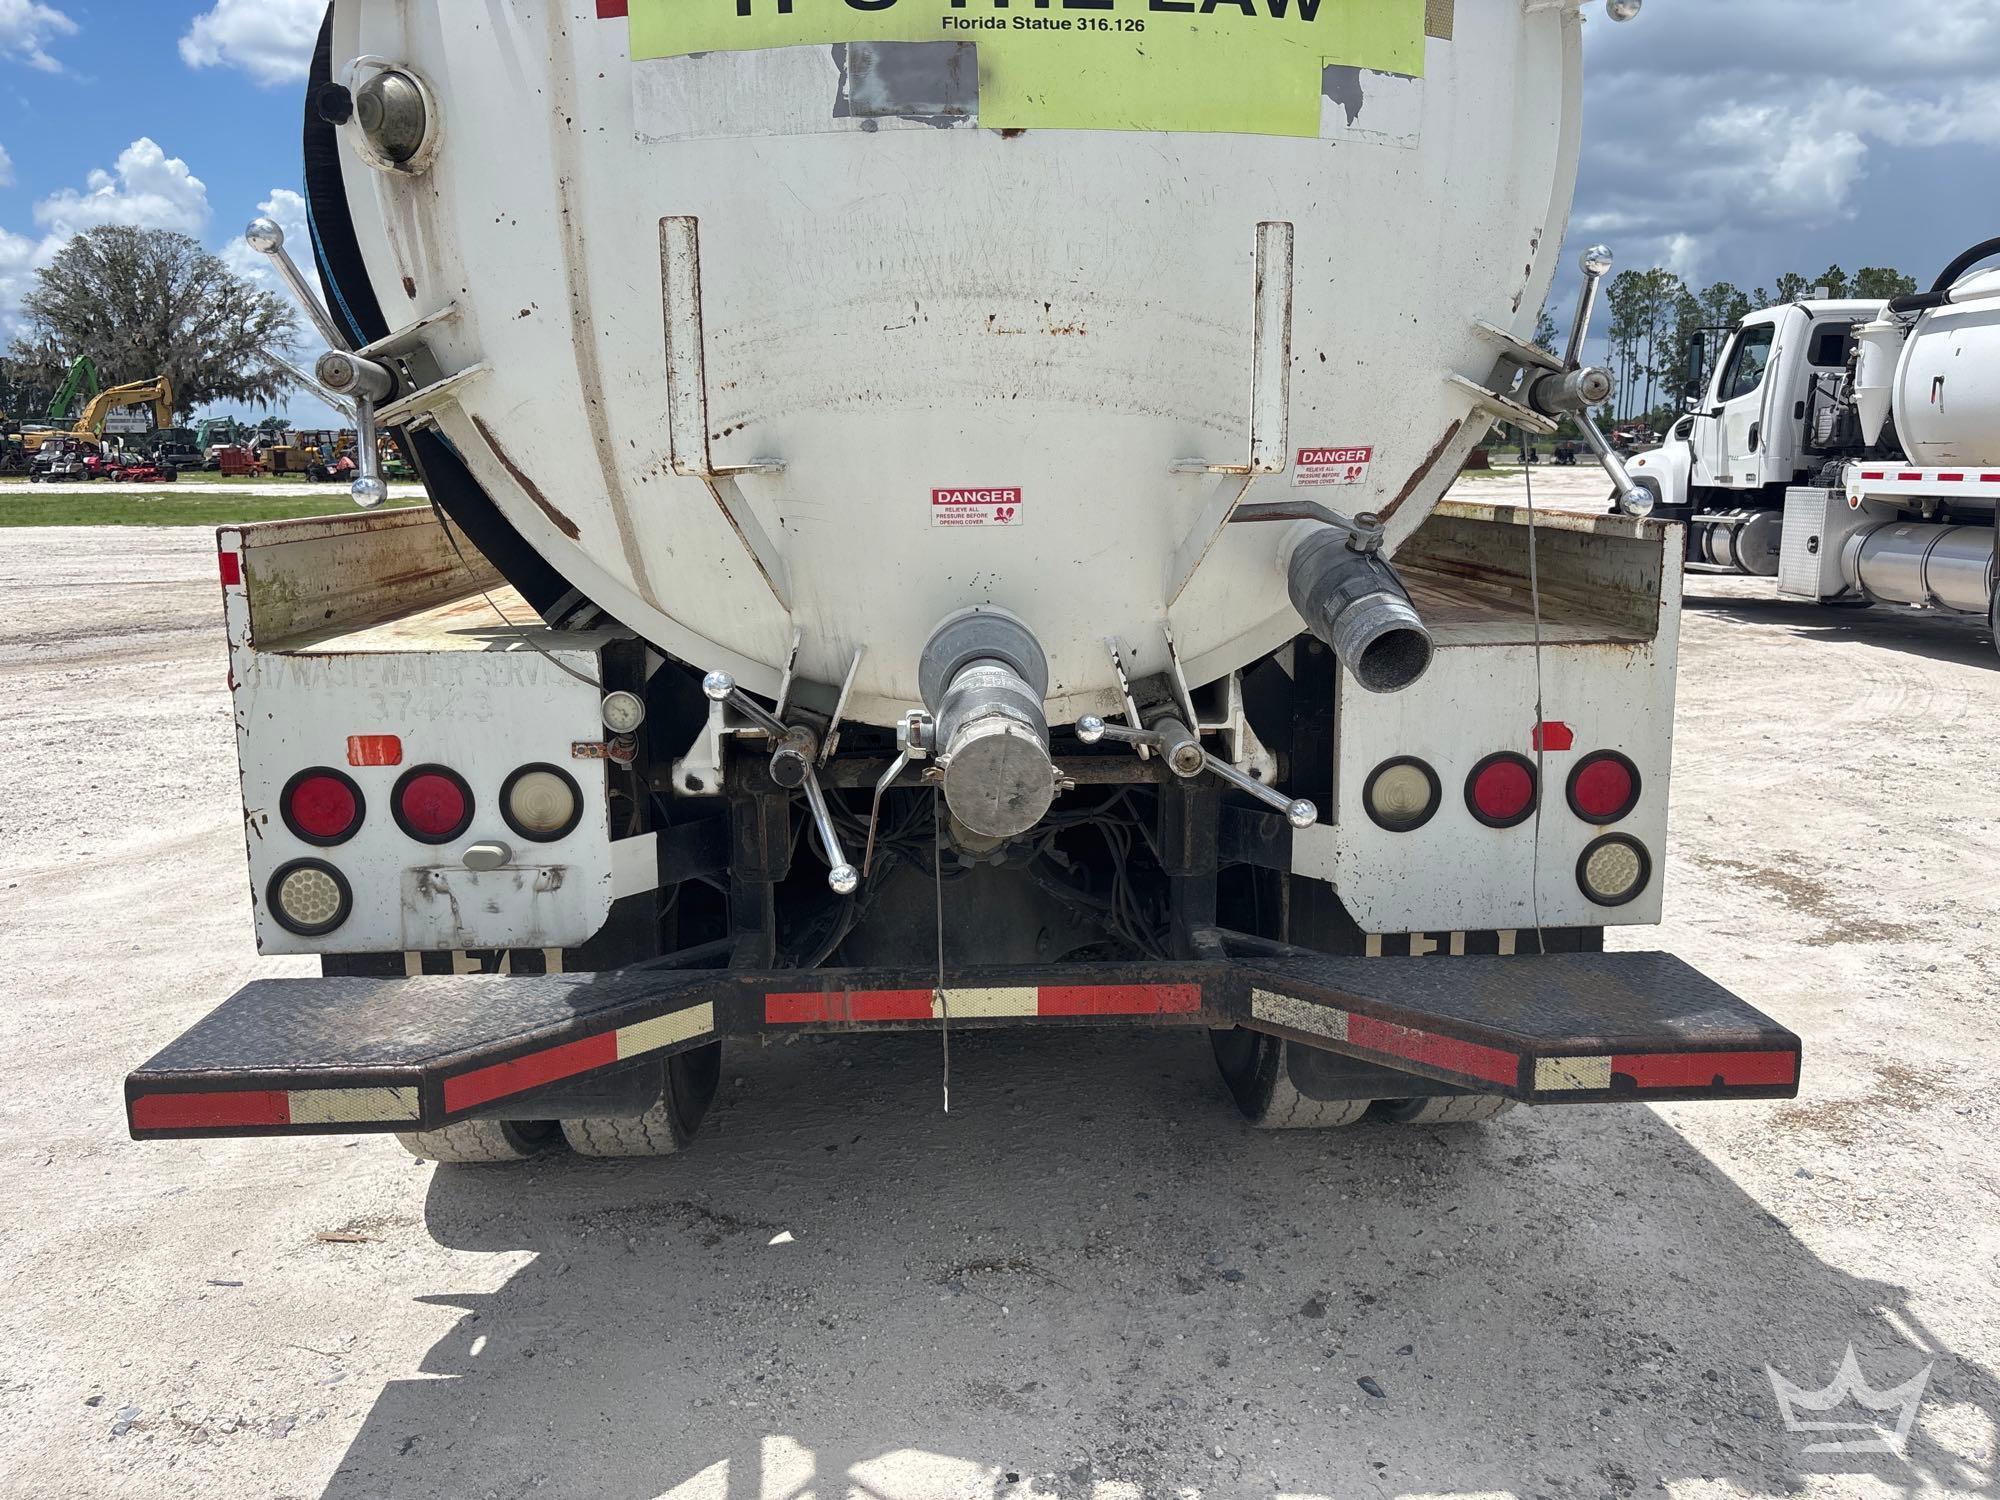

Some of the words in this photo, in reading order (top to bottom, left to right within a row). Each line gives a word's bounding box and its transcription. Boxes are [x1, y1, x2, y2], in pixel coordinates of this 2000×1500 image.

[942, 16, 1006, 29] Florida
[1012, 16, 1072, 30] Statue
[1076, 17, 1145, 32] 316.126
[1302, 450, 1367, 463] DANGER
[938, 490, 1015, 503] DANGER
